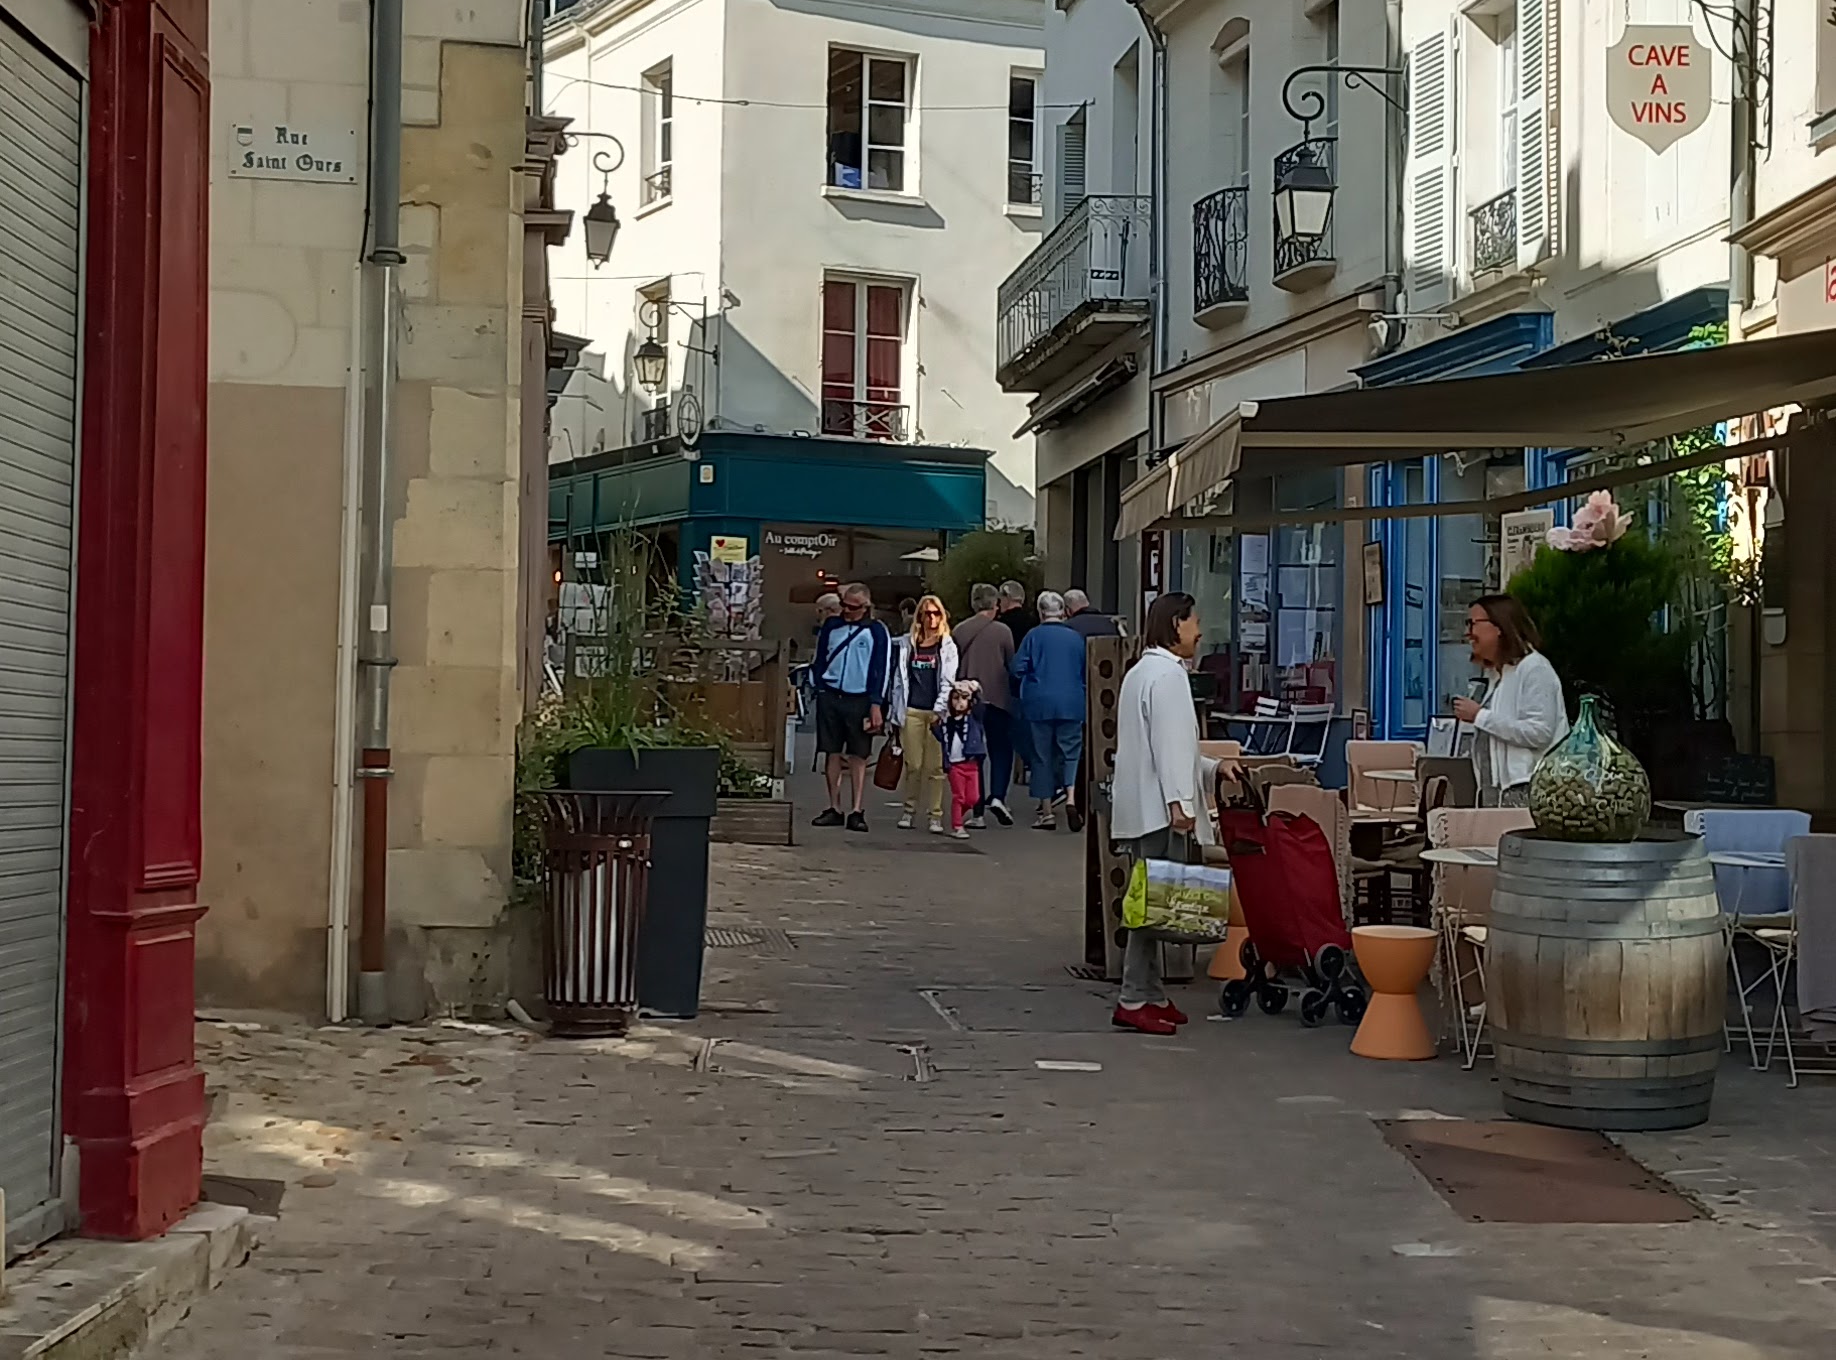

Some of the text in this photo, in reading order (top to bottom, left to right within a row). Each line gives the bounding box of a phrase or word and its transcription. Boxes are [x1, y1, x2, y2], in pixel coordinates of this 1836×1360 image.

[1628, 44, 1690, 67] CAVE
[1650, 73, 1668, 95] A
[1631, 101, 1687, 124] VINS
[275, 126, 308, 145] Rue
[242, 151, 342, 172] Saint Ours
[765, 531, 837, 548] Au comptOir
